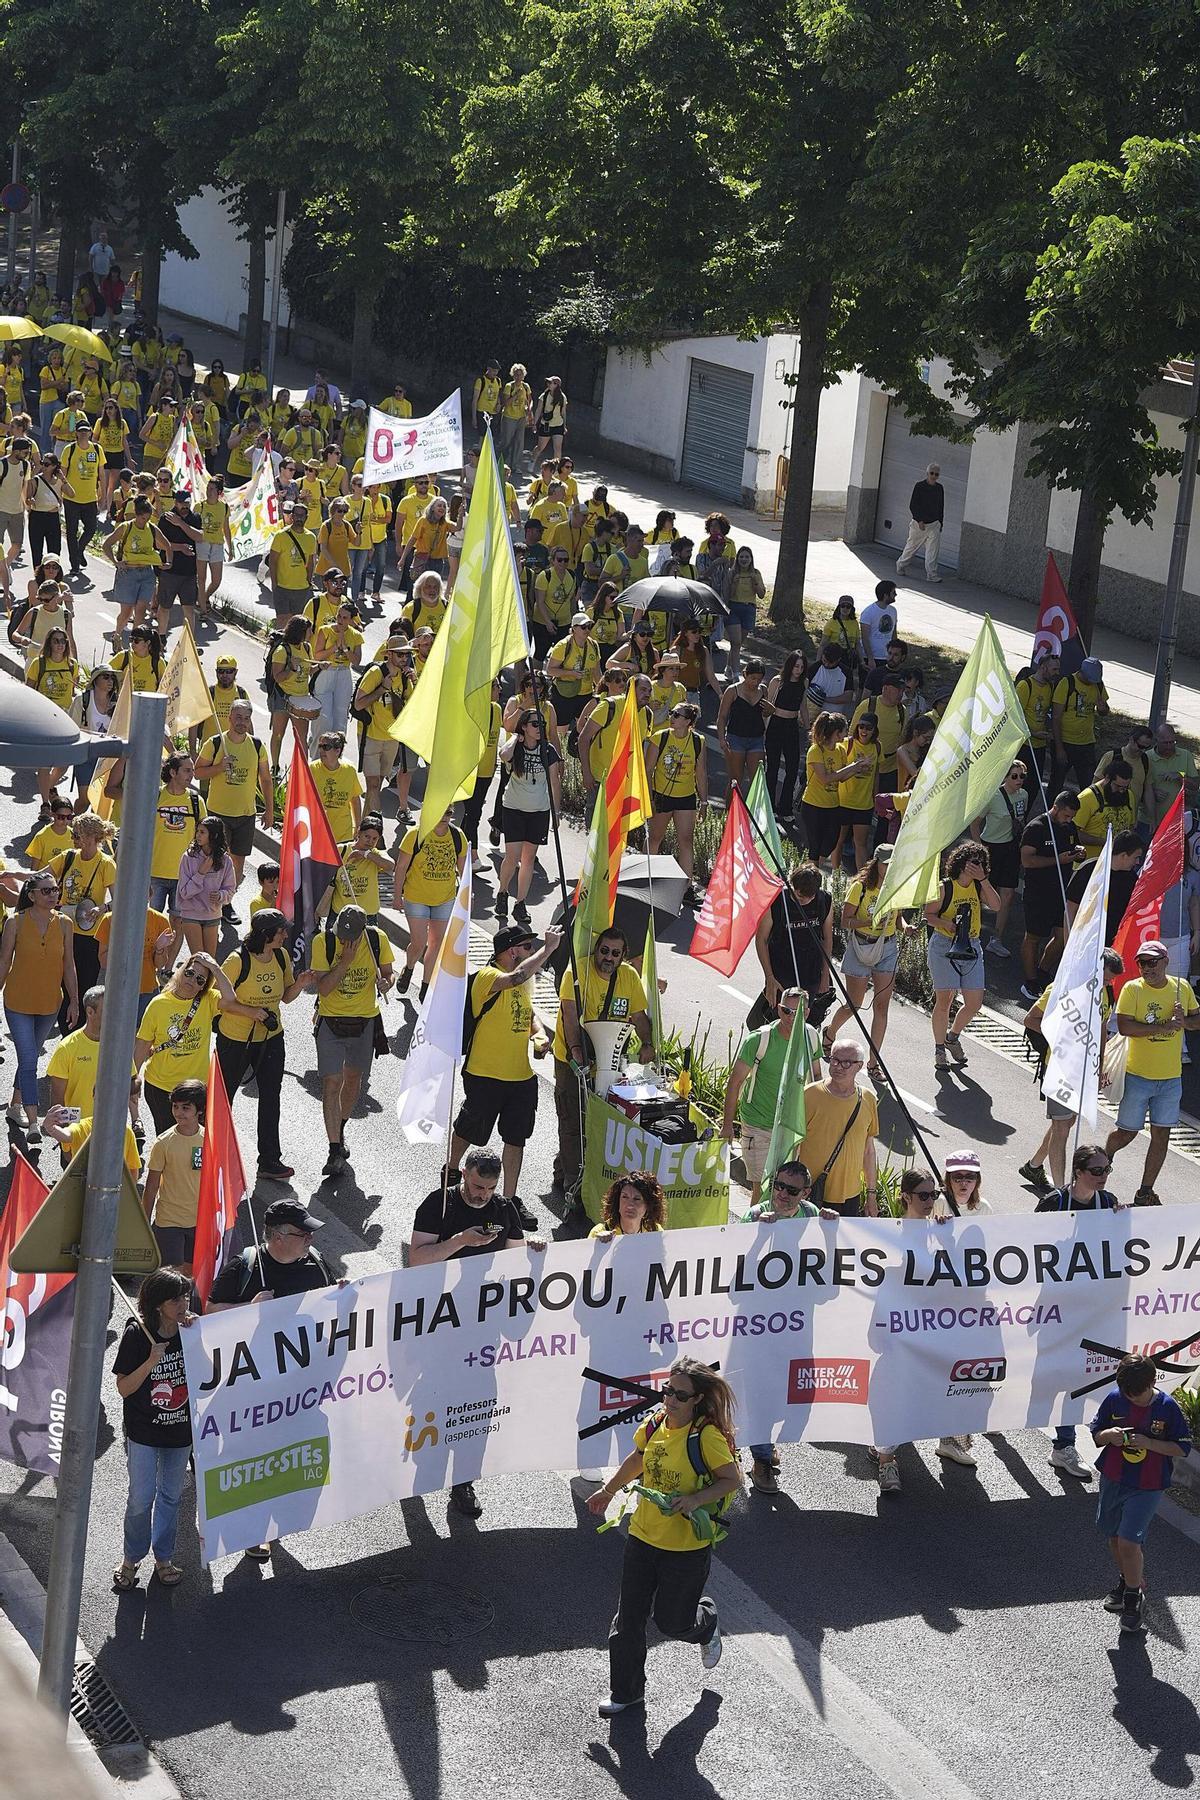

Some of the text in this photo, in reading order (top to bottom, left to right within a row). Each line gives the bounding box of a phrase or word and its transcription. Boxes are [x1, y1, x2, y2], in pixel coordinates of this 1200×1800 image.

[256, 972, 276, 982] SOS
[614, 998, 628, 1006] JO
[611, 1044, 622, 1072] USTEC
[704, 1185, 720, 1198] de
[200, 1341, 260, 1391] JA
[274, 1308, 374, 1374] N'HI
[393, 1292, 461, 1342] HA
[478, 1266, 627, 1323] PROU,
[646, 1247, 888, 1302] MILLORES
[904, 1237, 1151, 1288] LABORALS
[876, 1301, 1062, 1334] -BUROCRÀCIA
[643, 1310, 805, 1345] +RECURSOS
[463, 1333, 576, 1369] +SALARI
[163, 1361, 178, 1372] POT
[797, 1367, 835, 1378] INTER
[954, 1361, 1004, 1379] CGT
[796, 1378, 859, 1389] SINDICAL
[946, 1385, 1003, 1397] Ensenyament
[151, 1398, 171, 1406] CGT
[201, 1364, 394, 1440] A L'EDUCACIÓ:
[446, 1398, 497, 1416] Professors
[445, 1405, 511, 1428] de Secundària
[303, 1466, 323, 1481] IAC
